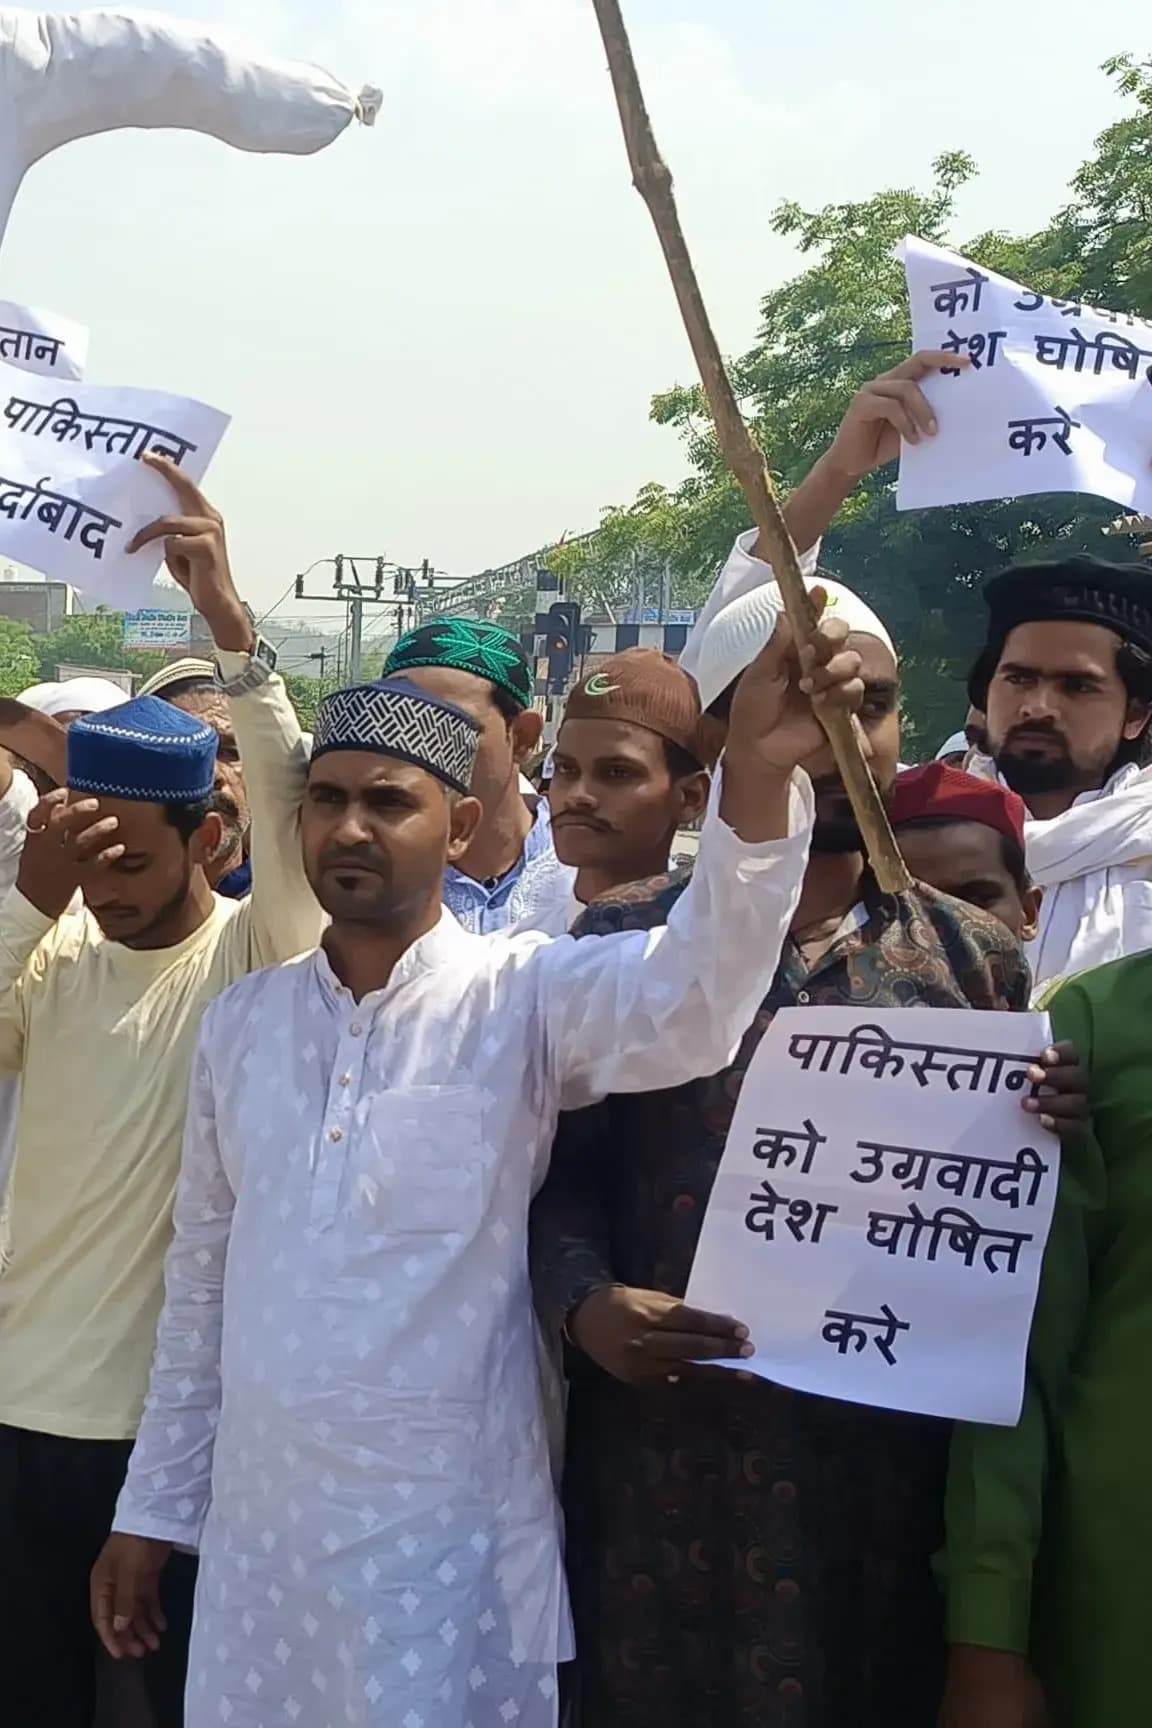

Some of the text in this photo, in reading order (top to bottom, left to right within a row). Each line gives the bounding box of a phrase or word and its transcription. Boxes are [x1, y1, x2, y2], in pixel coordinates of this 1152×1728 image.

[931, 267, 989, 317] को
[1034, 327, 1152, 386] घोषि
[3, 398, 198, 466] पाकिस्तान
[1008, 406, 1081, 456] करे
[788, 1024, 1043, 1098] पाकिस्तान
[752, 1119, 1048, 1208] को उग्रवादी
[744, 1181, 1033, 1274] देश घोषित
[821, 1304, 910, 1365] करे
